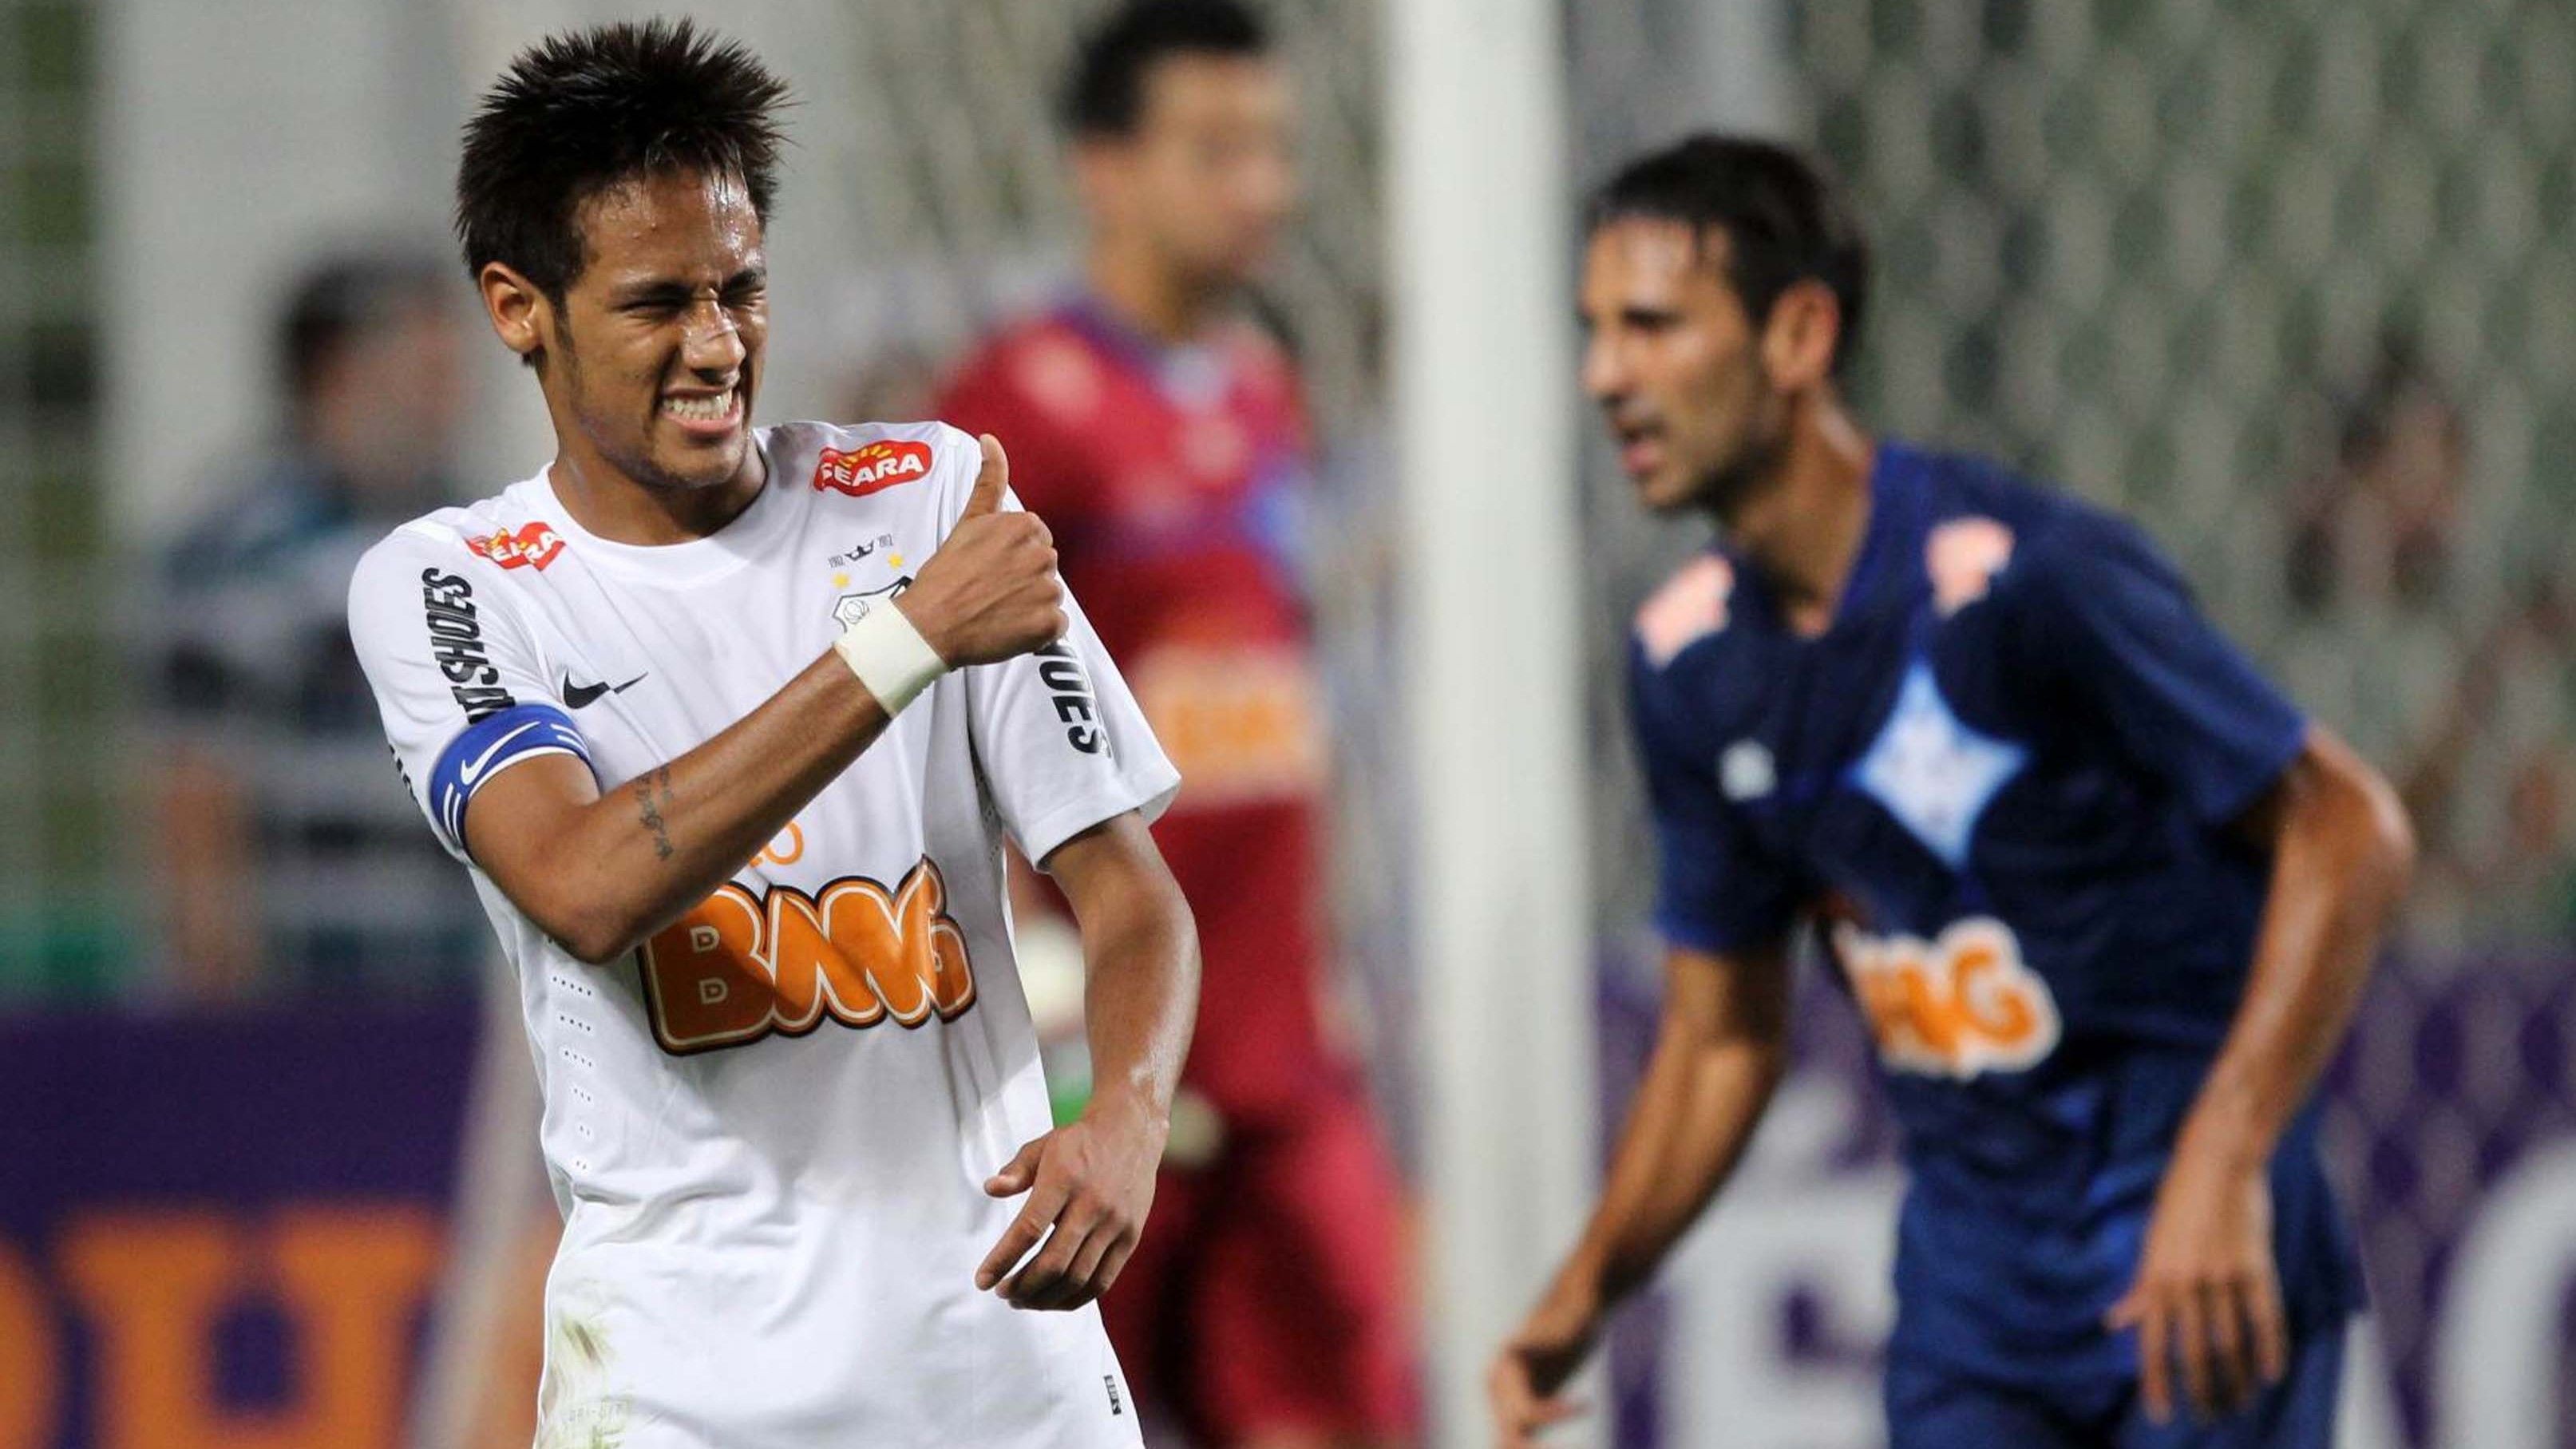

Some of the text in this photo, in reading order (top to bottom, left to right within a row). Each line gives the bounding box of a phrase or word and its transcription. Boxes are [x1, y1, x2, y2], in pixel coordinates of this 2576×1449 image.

[820, 452, 924, 487] SEARA
[421, 568, 516, 725] TSHOES
[639, 853, 975, 1056] BMG
